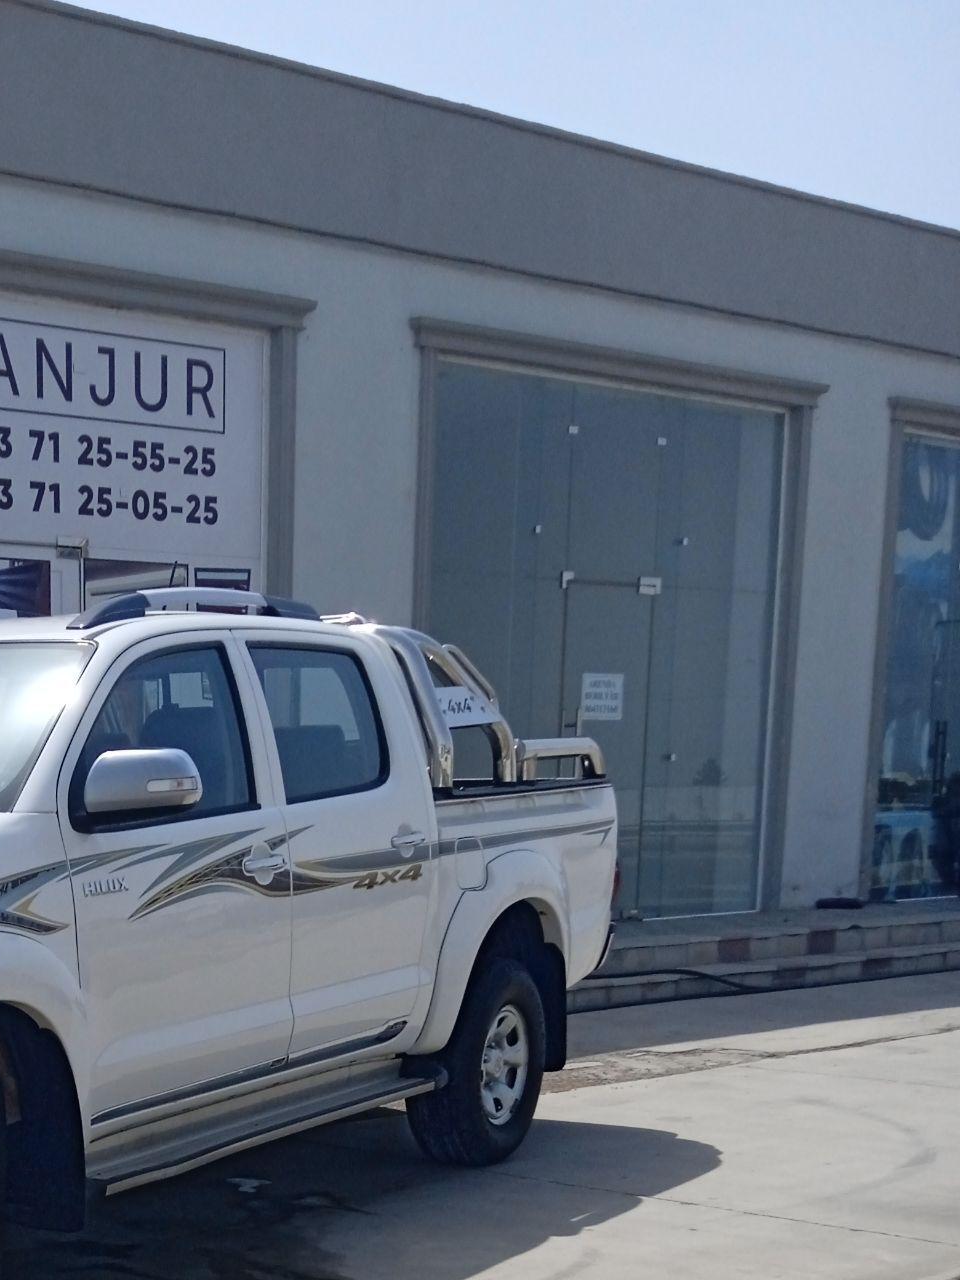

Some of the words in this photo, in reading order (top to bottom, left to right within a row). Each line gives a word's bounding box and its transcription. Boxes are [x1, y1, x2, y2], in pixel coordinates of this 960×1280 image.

[29, 429, 60, 463] 71
[77, 434, 217, 477] 25-55-25
[30, 480, 61, 514] 71
[78, 485, 219, 525] 25-05-25
[82, 877, 129, 897] HILUX
